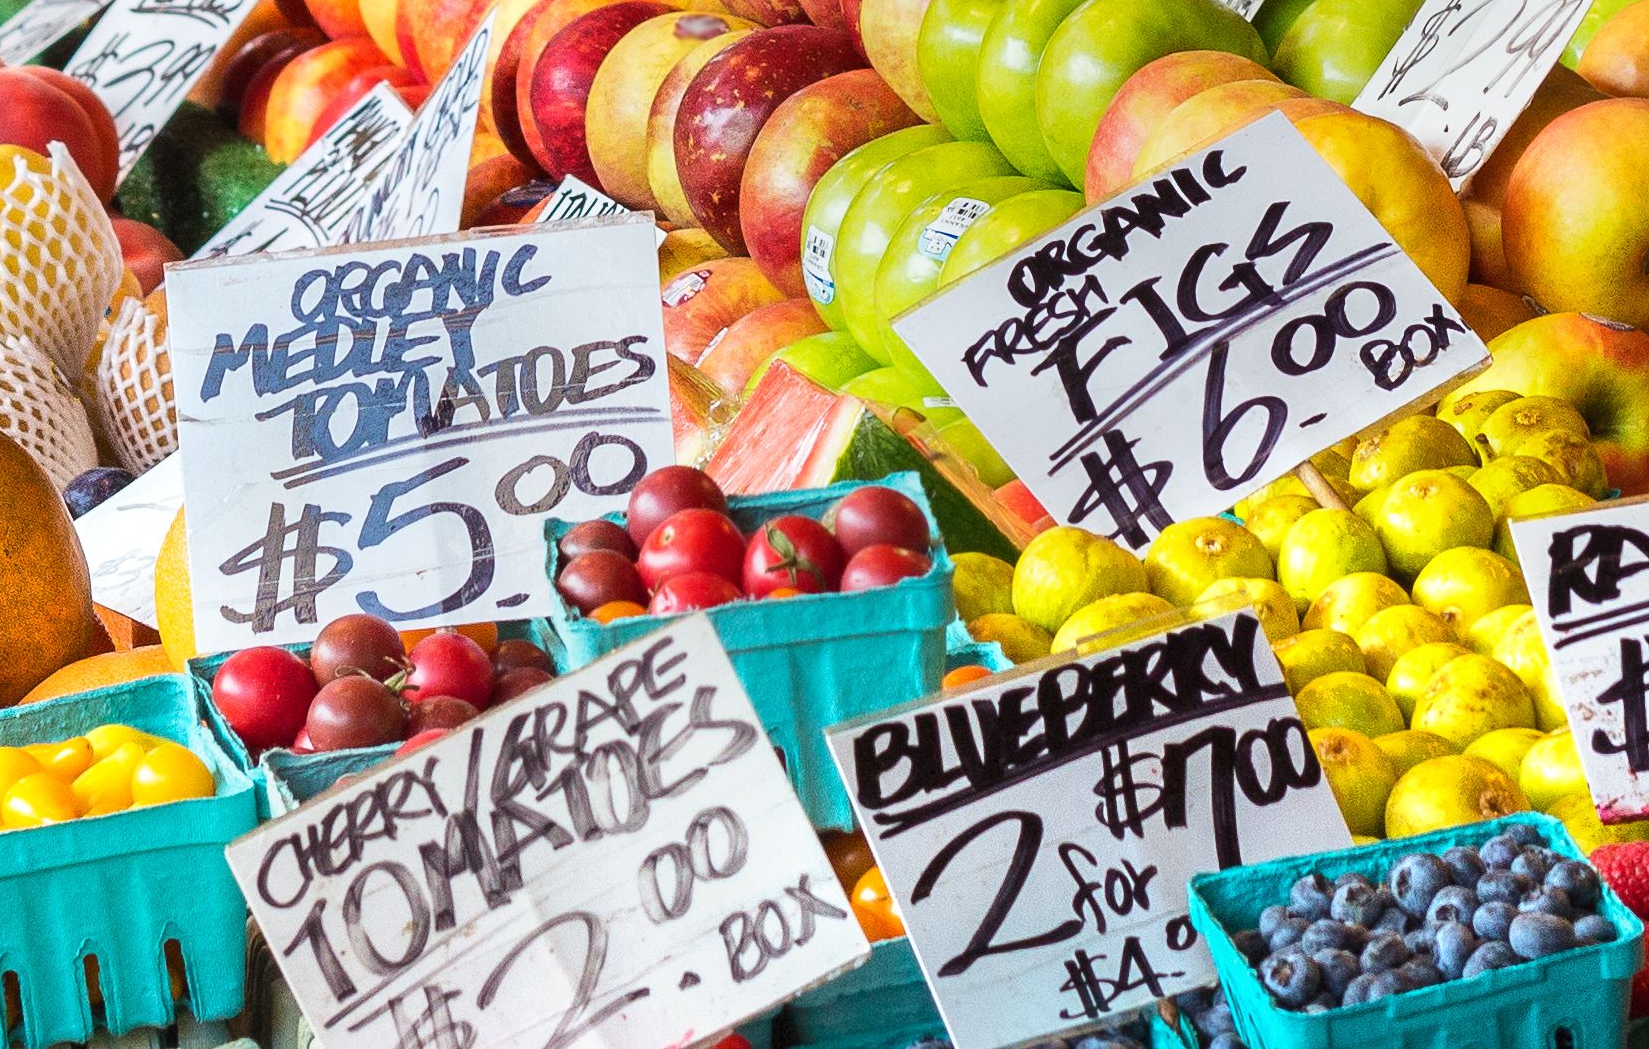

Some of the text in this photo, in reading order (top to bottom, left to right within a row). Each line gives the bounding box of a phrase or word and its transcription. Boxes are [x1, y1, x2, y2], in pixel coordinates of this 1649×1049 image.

[290, 243, 553, 326] ORGANIC
[1006, 148, 1248, 309] ORGANIC
[199, 304, 490, 403] MEDLEY
[961, 274, 1109, 388] FRESH
[1030, 200, 1335, 425] FIGS
[1358, 302, 1468, 392] BOX
[254, 335, 657, 463] TOMATOES
[851, 613, 1264, 810] BLUEBERRY
[284, 686, 760, 1003] TOMATOES
[910, 810, 1158, 978] 2 for
[717, 872, 850, 986] BOX
